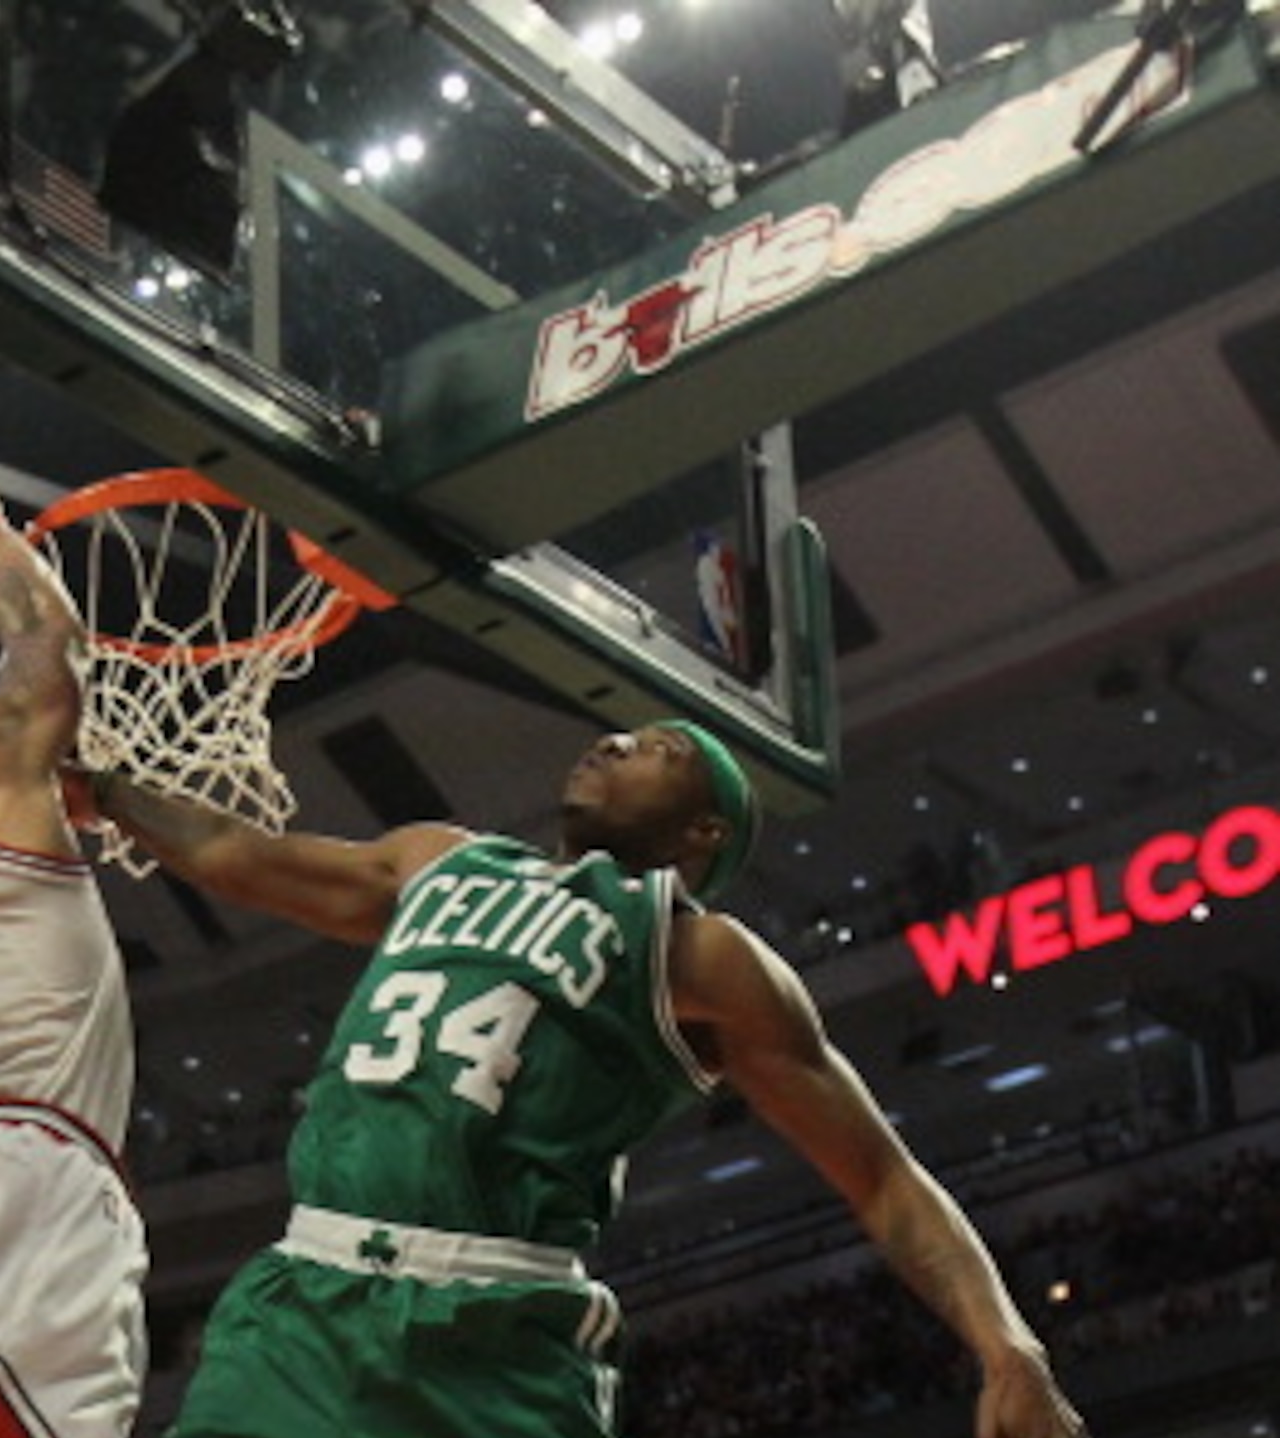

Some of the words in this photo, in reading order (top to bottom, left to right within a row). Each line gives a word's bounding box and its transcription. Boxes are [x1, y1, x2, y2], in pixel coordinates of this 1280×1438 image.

[382, 873, 623, 1008] CELTICS
[907, 805, 1280, 997] WELCO
[344, 970, 540, 1115] 34
